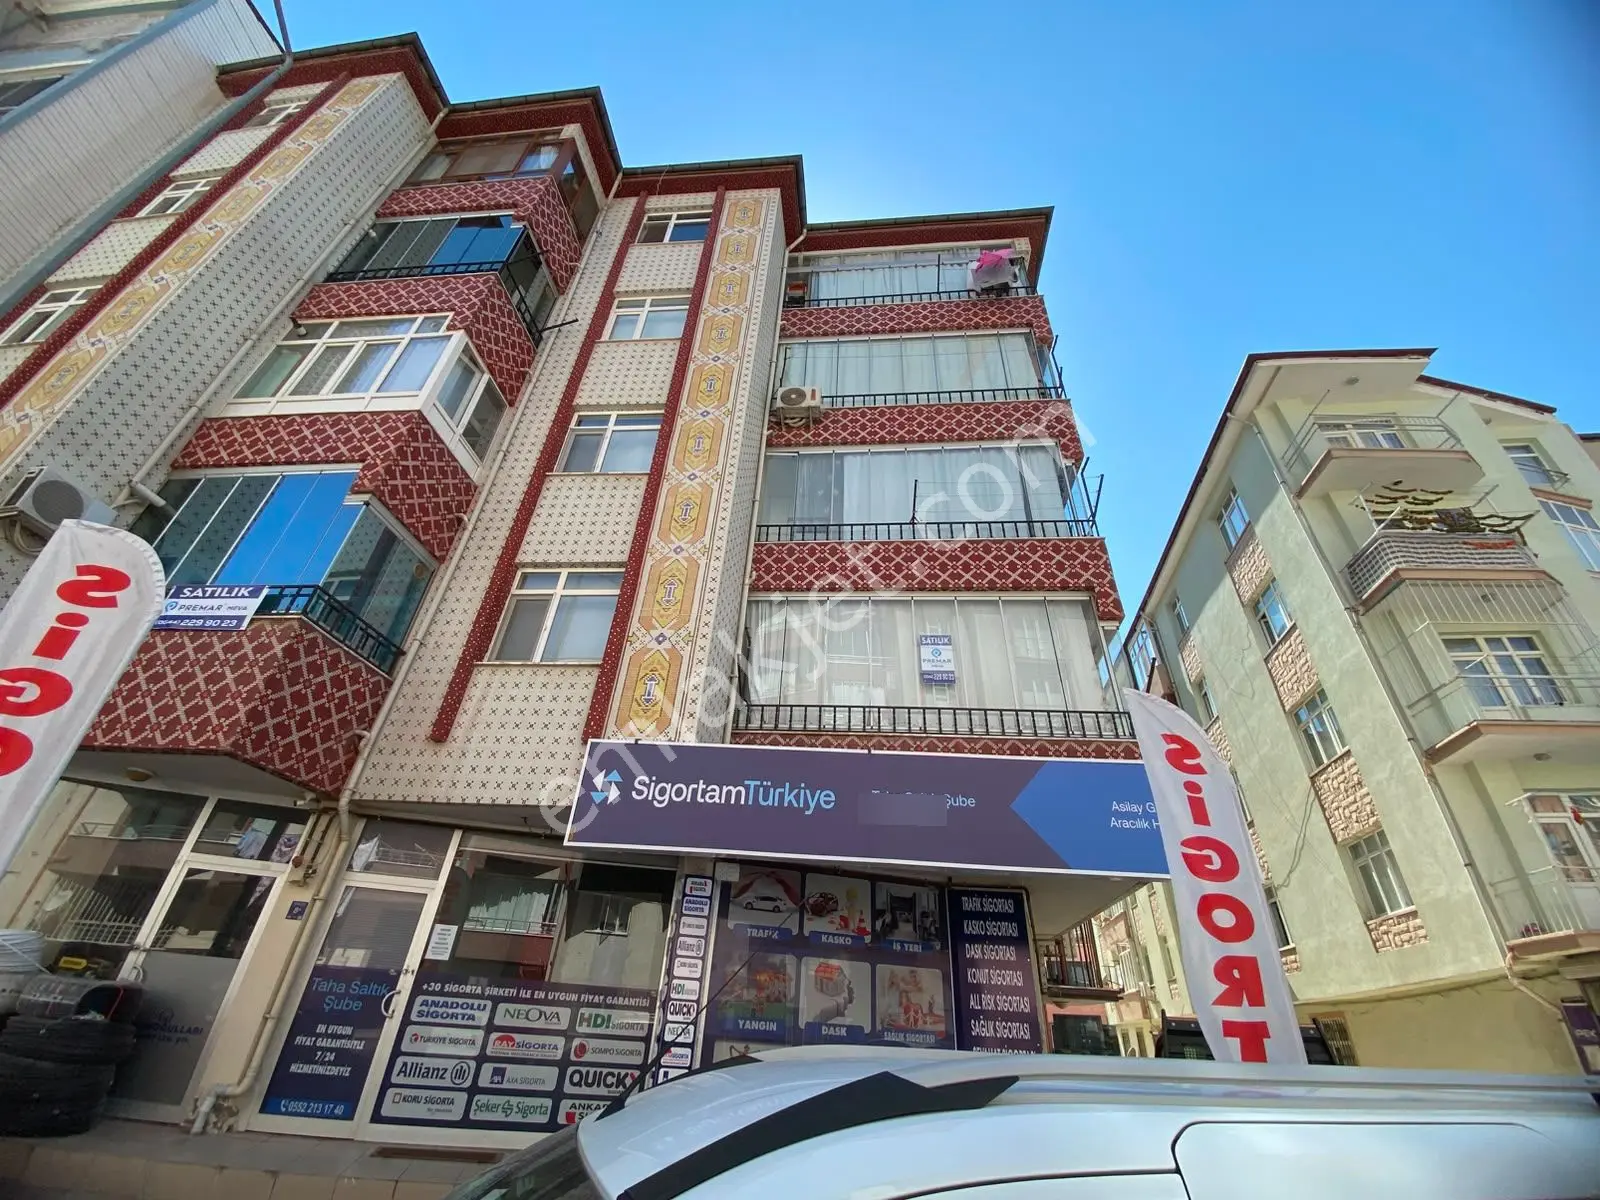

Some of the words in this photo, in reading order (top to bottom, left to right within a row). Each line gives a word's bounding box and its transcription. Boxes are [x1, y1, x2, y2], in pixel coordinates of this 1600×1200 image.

[180, 587, 253, 598] SATILIK
[178, 604, 223, 612] PREMAR
[180, 619, 203, 627] 229
[204, 619, 220, 627] 90
[221, 619, 237, 627] 23
[921, 636, 950, 645] SATILIK
[1111, 801, 1143, 815] Asilay
[1110, 816, 1151, 829] Aracılık
[961, 894, 982, 911] TRAFİK
[982, 895, 1015, 913] SİGORTASI
[963, 920, 985, 935] KASKO
[986, 917, 1019, 937] SİGORTASI
[821, 934, 852, 945] KASKO
[903, 941, 922, 952] YERİ
[965, 944, 983, 960] DASK
[983, 941, 1017, 961] SİGORTASI
[967, 968, 989, 984] KONUT
[989, 966, 1024, 986] SİGORTASI
[311, 977, 346, 993] Taha
[349, 981, 391, 996] Saltık
[422, 982, 441, 992] +30
[444, 981, 482, 995] SİGORTA
[484, 985, 517, 998] ŞİRKETİ
[519, 988, 531, 998] İLE
[534, 990, 546, 999] EN
[547, 991, 578, 1001] UYGUN
[580, 992, 604, 1003] FİYAT
[606, 996, 650, 1007] GARANTİSİ
[323, 996, 363, 1012] Şube
[420, 999, 487, 1012] ANADOLU
[970, 993, 981, 1010] ALL
[981, 990, 996, 1010] RİSK
[996, 992, 1030, 1013] SİGORTASI
[416, 1008, 476, 1021] SİGORTA
[504, 1007, 560, 1022] NEOVA
[578, 1012, 612, 1029] HDI
[316, 1024, 327, 1034] EN
[327, 1025, 353, 1035] UYGUN
[738, 1019, 777, 1031] YANGIN
[821, 1026, 847, 1037] DASK
[971, 1016, 995, 1037] SAĞLIK
[996, 1017, 1031, 1040] SİGORTASI
[294, 1034, 316, 1046] FİYAT
[591, 1046, 614, 1055] SOMPO
[397, 1062, 448, 1081] Allianz
[569, 1069, 631, 1089] QUICK
[402, 1092, 423, 1103] KORU
[423, 1092, 455, 1106] SİGORTA
[307, 1102, 322, 1114] 213
[324, 1103, 334, 1114] 17
[334, 1104, 345, 1115] 40
[474, 1100, 501, 1116] Şeker
[515, 1101, 548, 1119] Sigorta
